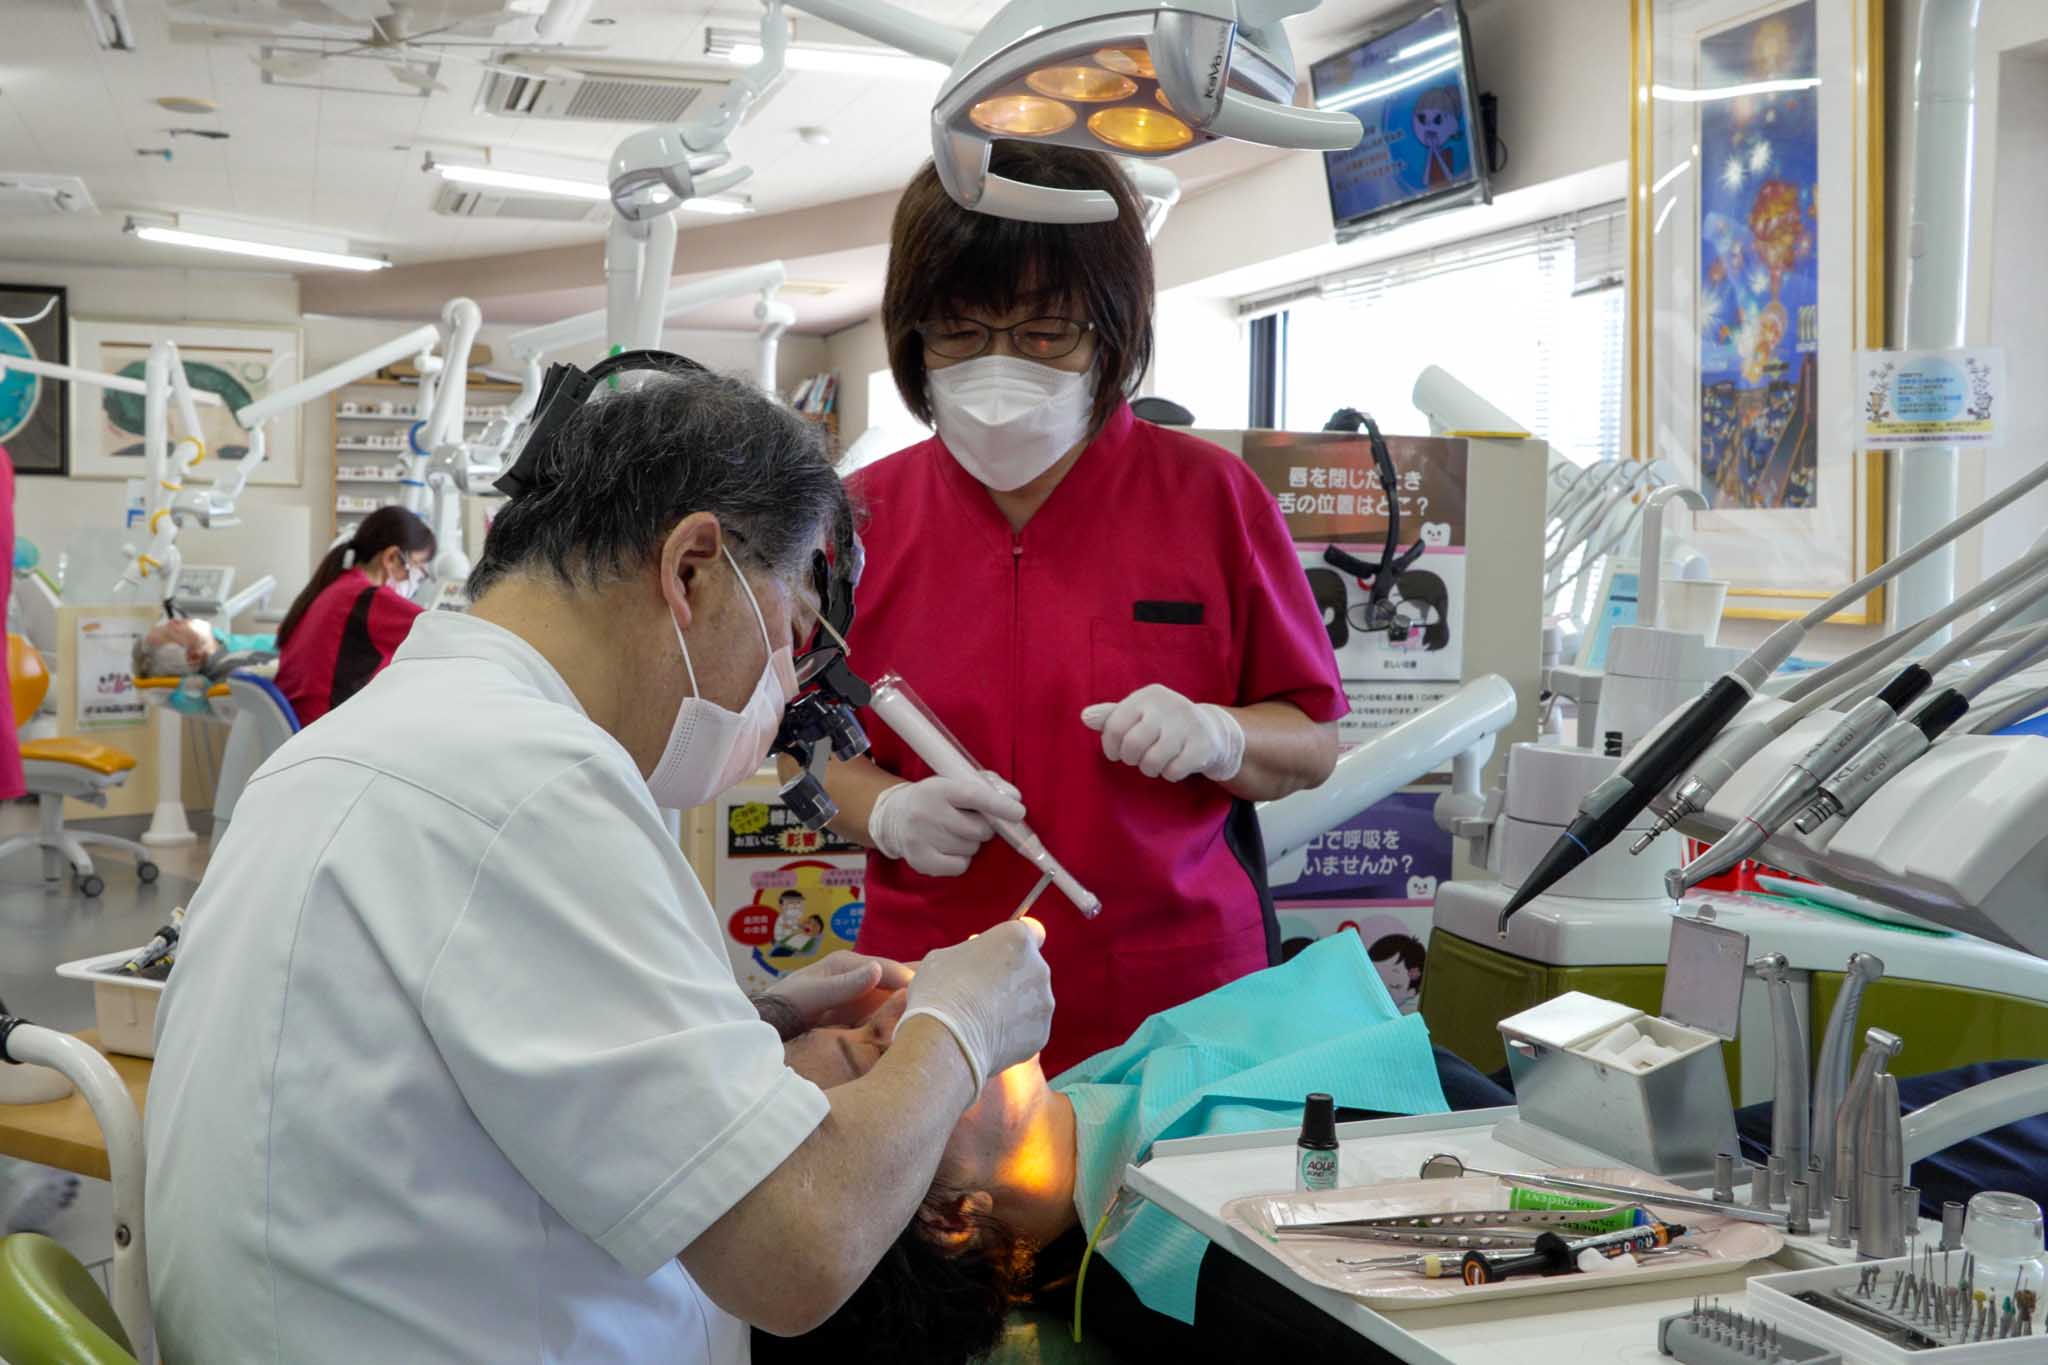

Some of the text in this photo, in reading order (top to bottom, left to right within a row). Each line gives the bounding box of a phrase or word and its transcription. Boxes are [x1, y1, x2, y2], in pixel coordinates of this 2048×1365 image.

[1288, 466, 1423, 491] 唇を閉じたき
[1307, 1160, 1335, 1171] AQUA
